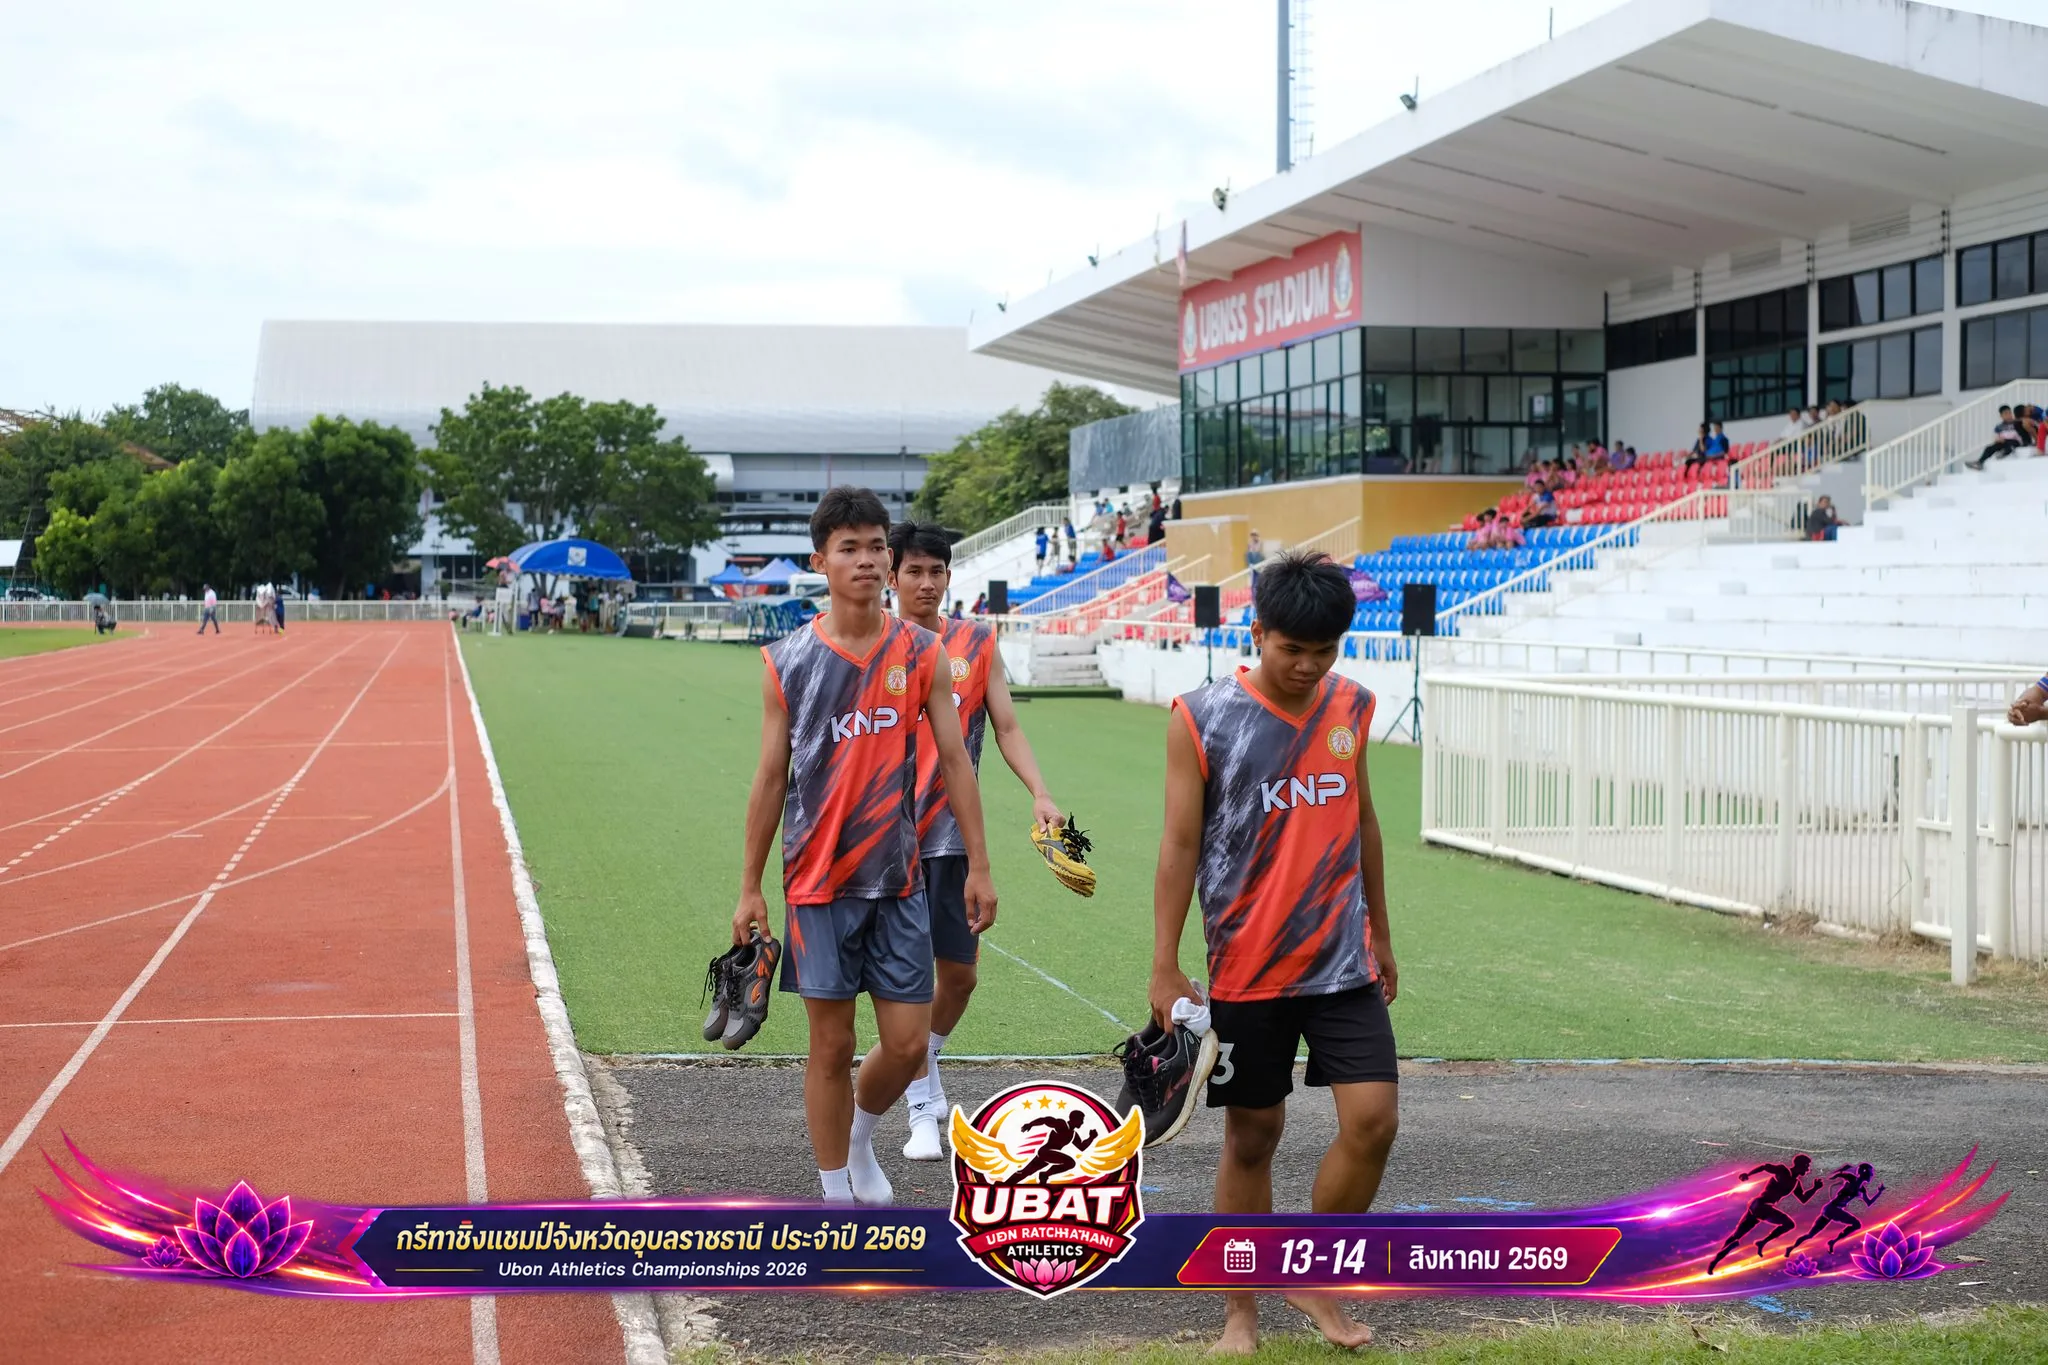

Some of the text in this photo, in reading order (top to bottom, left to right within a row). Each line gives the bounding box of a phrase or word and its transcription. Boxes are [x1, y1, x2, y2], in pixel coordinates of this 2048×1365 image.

[1255, 263, 1330, 336] STADIUM
[829, 705, 900, 744] KNP
[1259, 772, 1348, 814] KNP
[1210, 1042, 1235, 1086] 3
